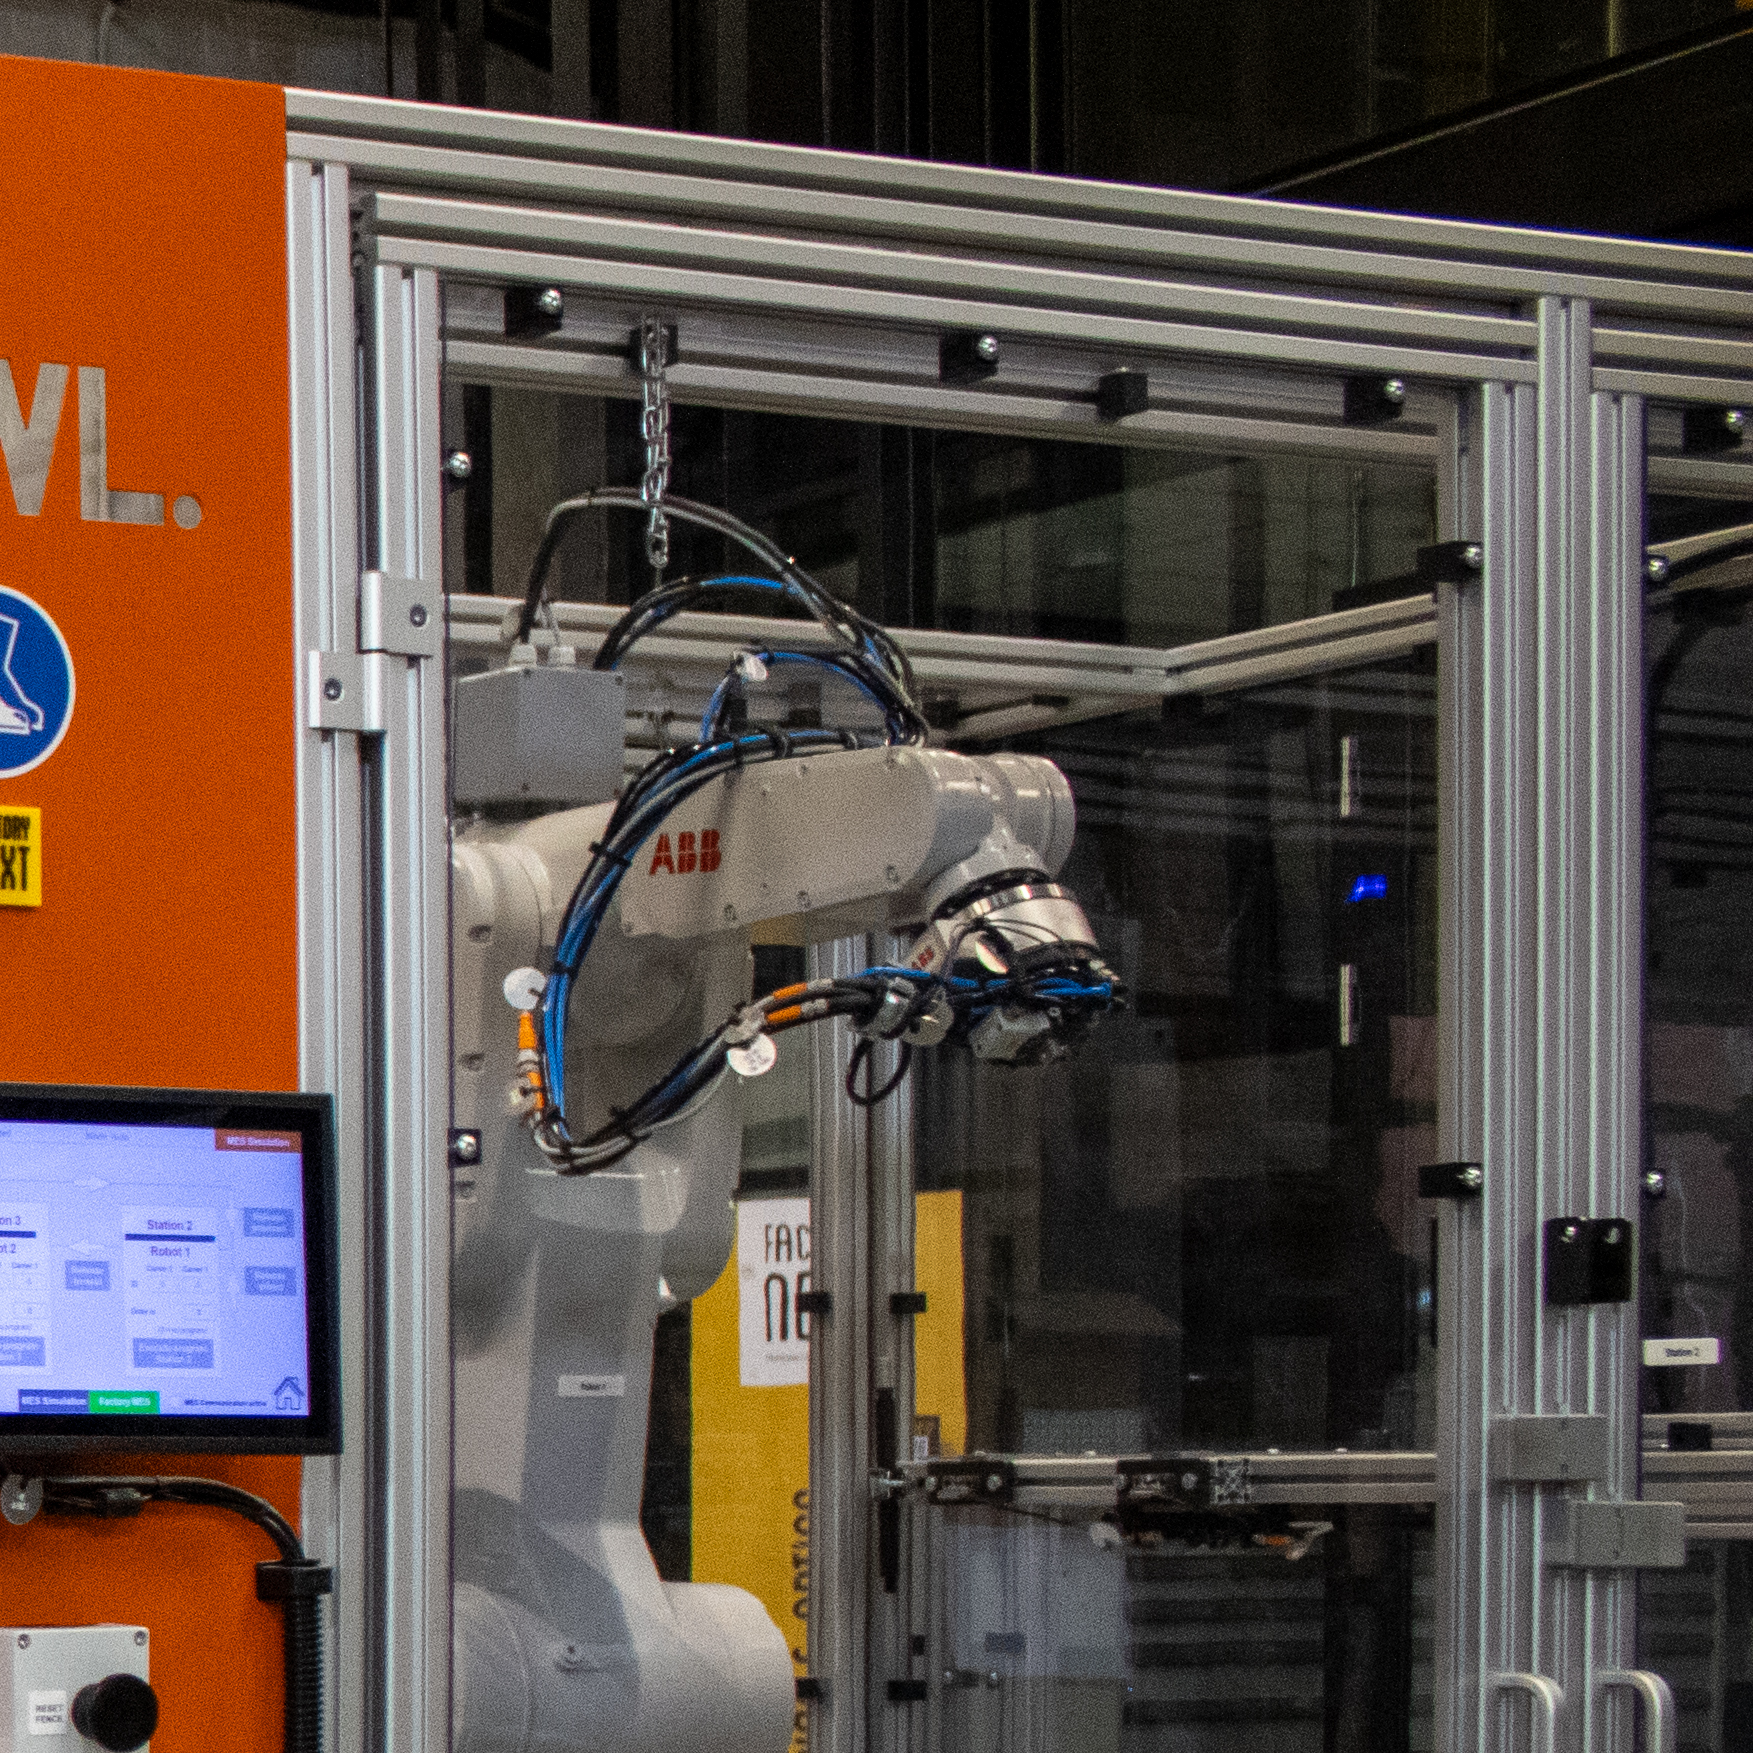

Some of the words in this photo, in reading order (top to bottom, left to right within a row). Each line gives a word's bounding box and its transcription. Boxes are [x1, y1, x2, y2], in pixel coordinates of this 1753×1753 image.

[649, 829, 722, 876] ABB
[147, 1219, 184, 1231] Station
[150, 1246, 183, 1257] Robot
[98, 1397, 131, 1409] Factory
